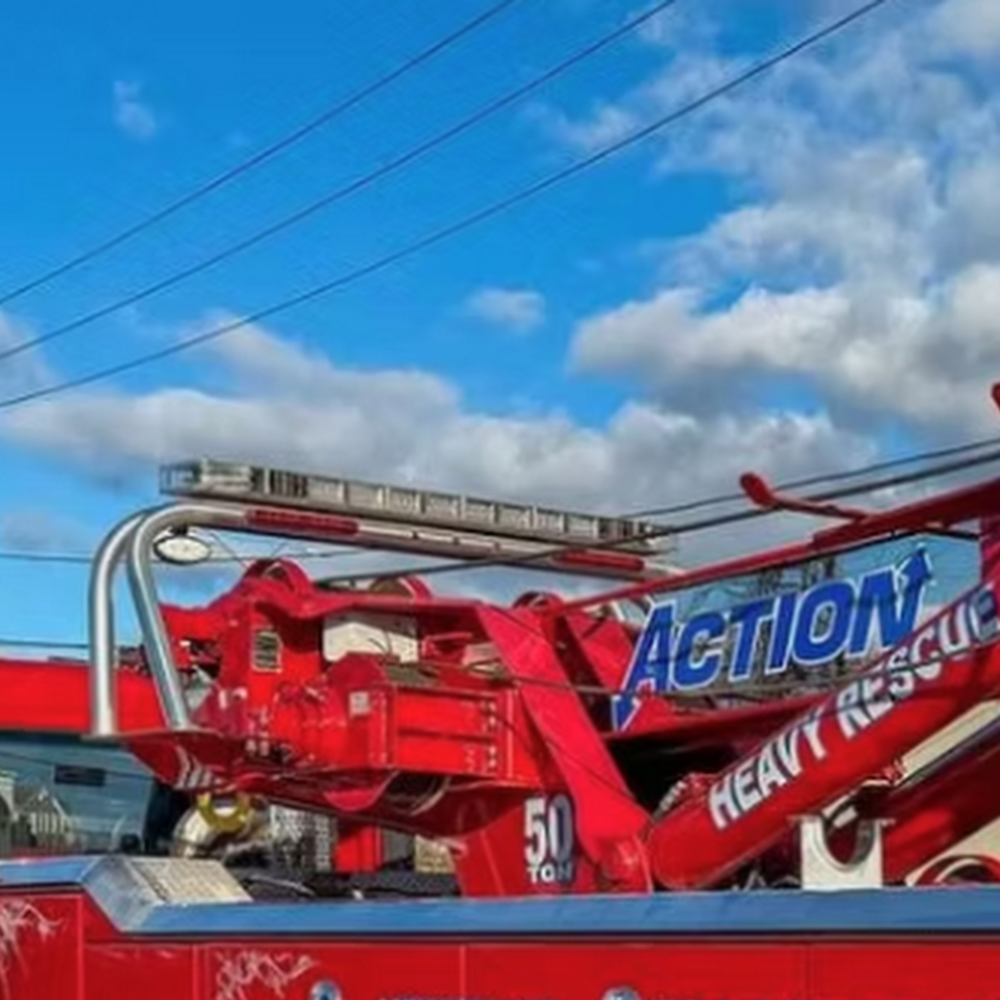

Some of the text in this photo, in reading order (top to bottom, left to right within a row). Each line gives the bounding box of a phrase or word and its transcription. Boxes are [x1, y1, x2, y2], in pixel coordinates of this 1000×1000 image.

[611, 545, 932, 732] ACTION
[708, 706, 826, 830] HEAVY
[523, 794, 574, 868] 50
[526, 861, 573, 884] TON
